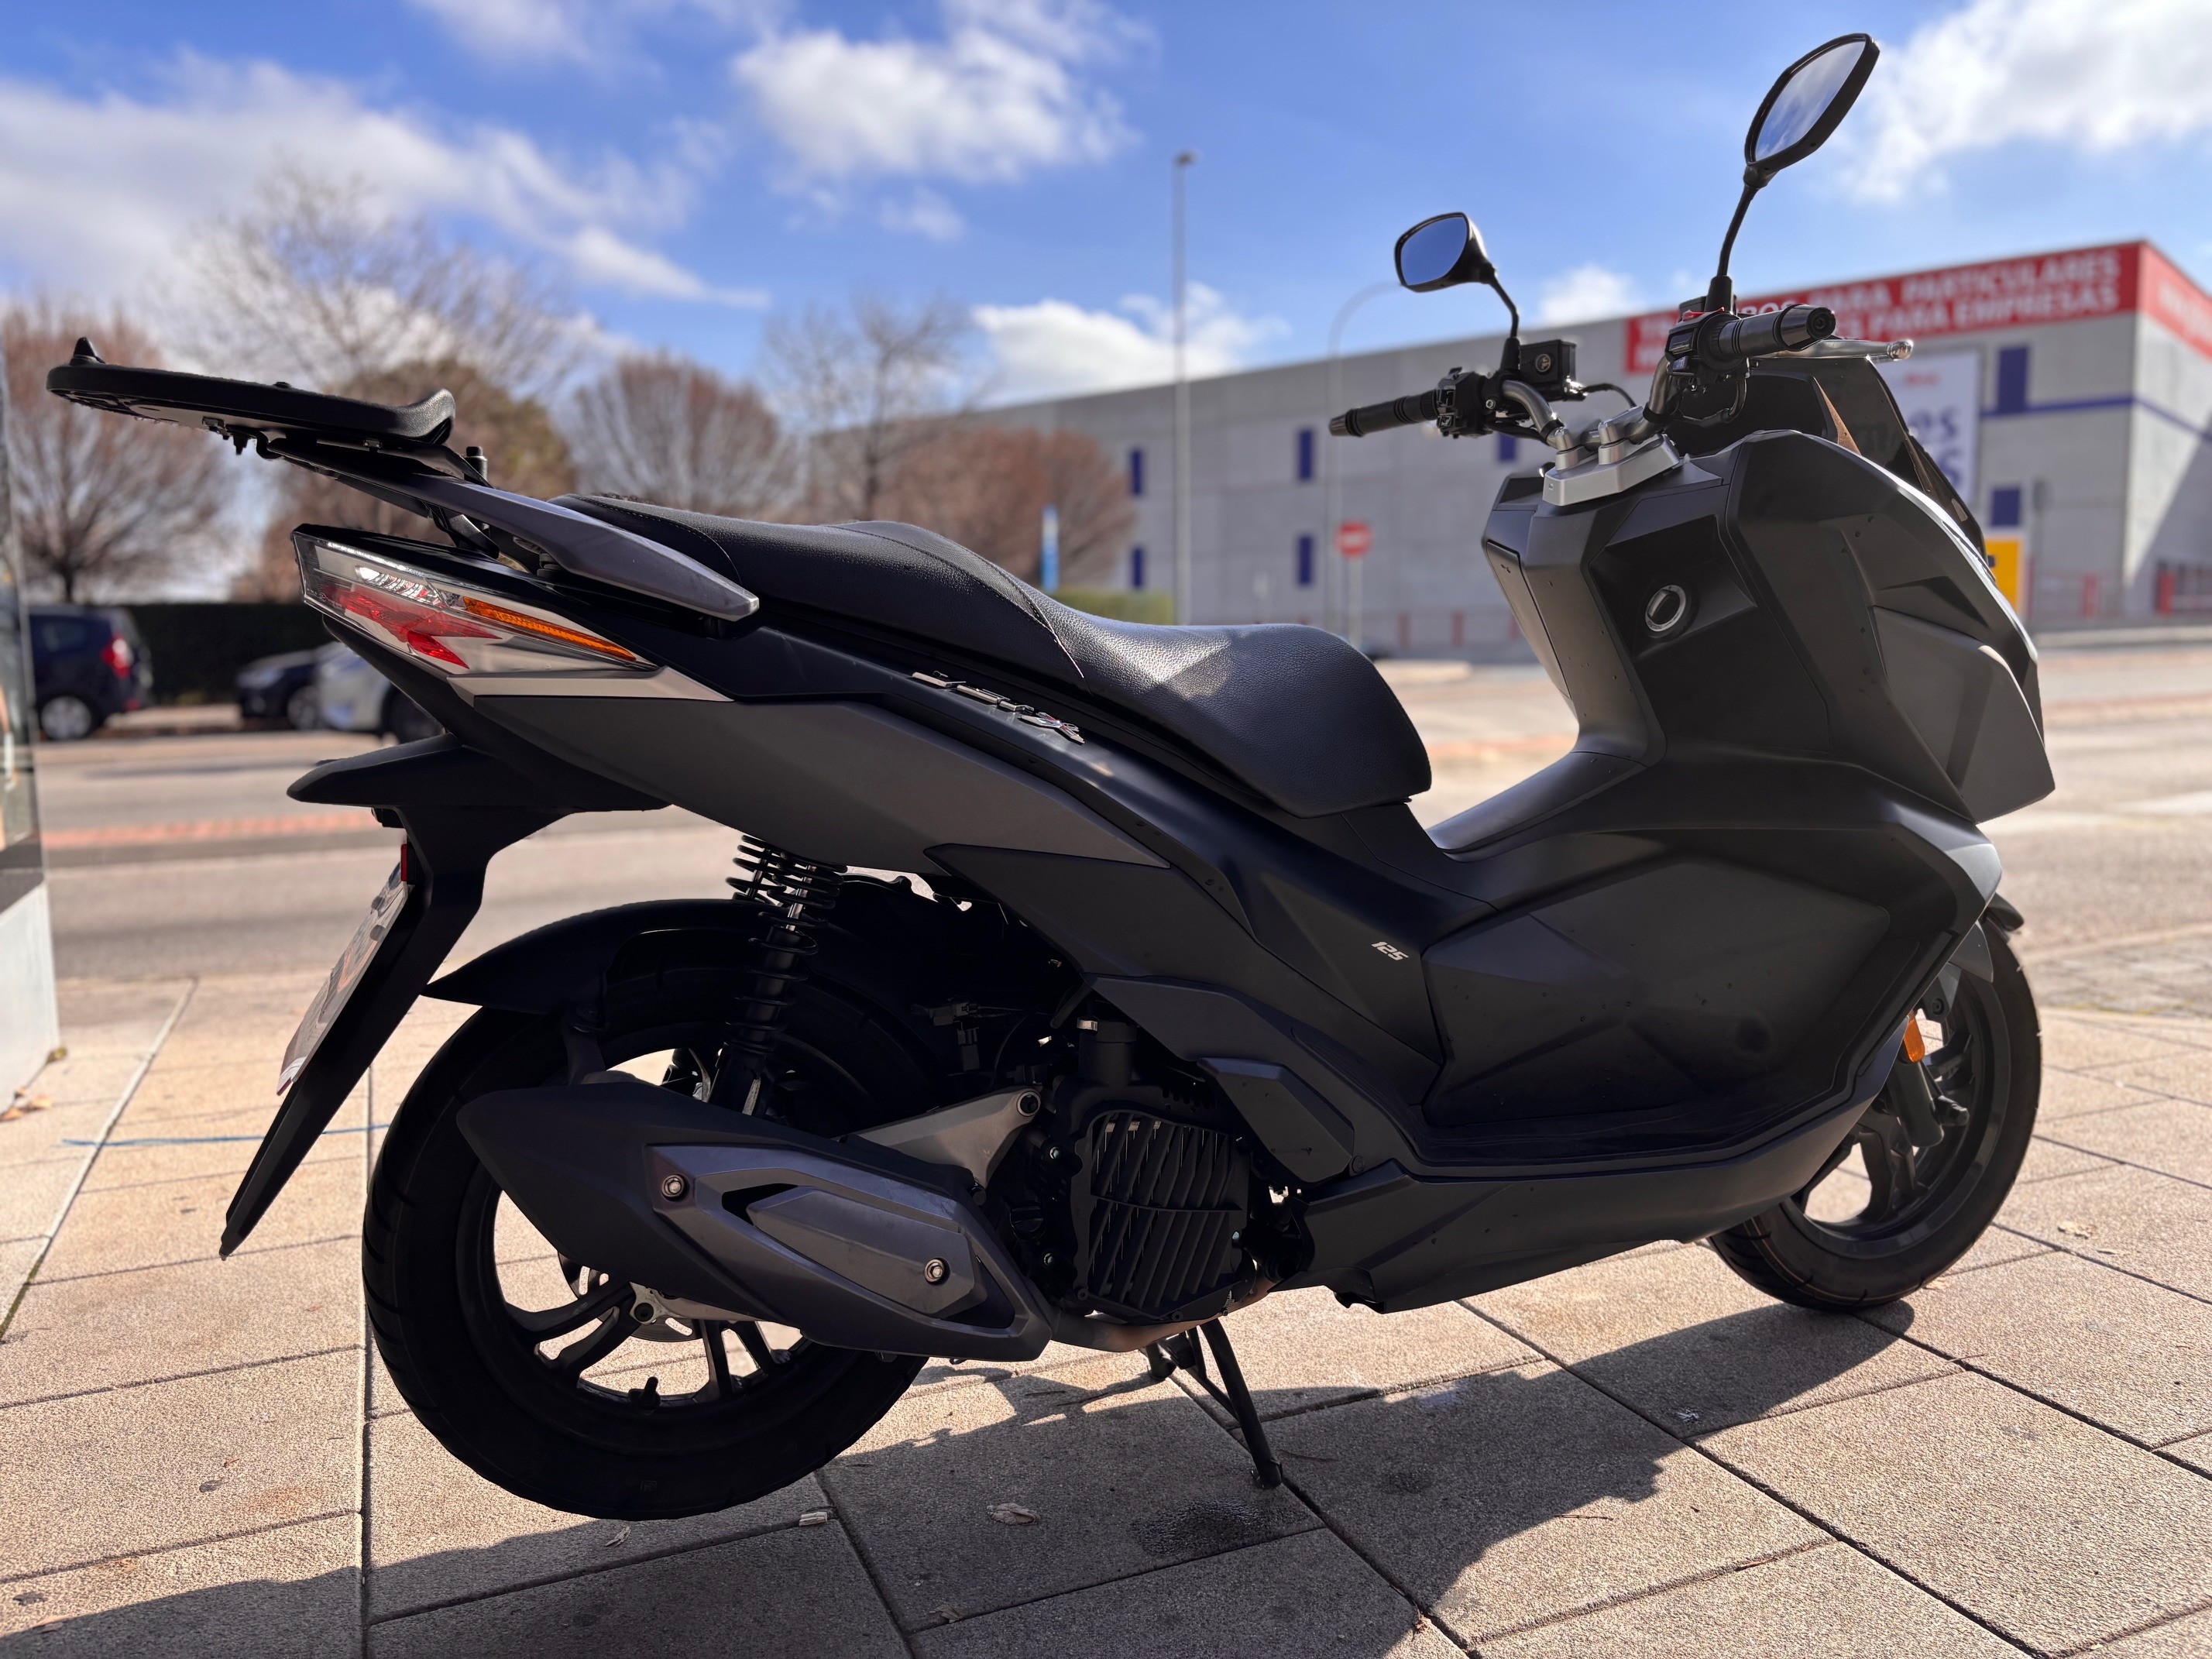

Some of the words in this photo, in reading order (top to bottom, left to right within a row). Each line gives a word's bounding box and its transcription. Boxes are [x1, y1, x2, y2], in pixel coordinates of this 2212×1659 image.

[1903, 252, 2120, 303] PARTICULARES
[1954, 282, 2119, 328] EMPRESAS
[1371, 942, 1409, 960] 125
